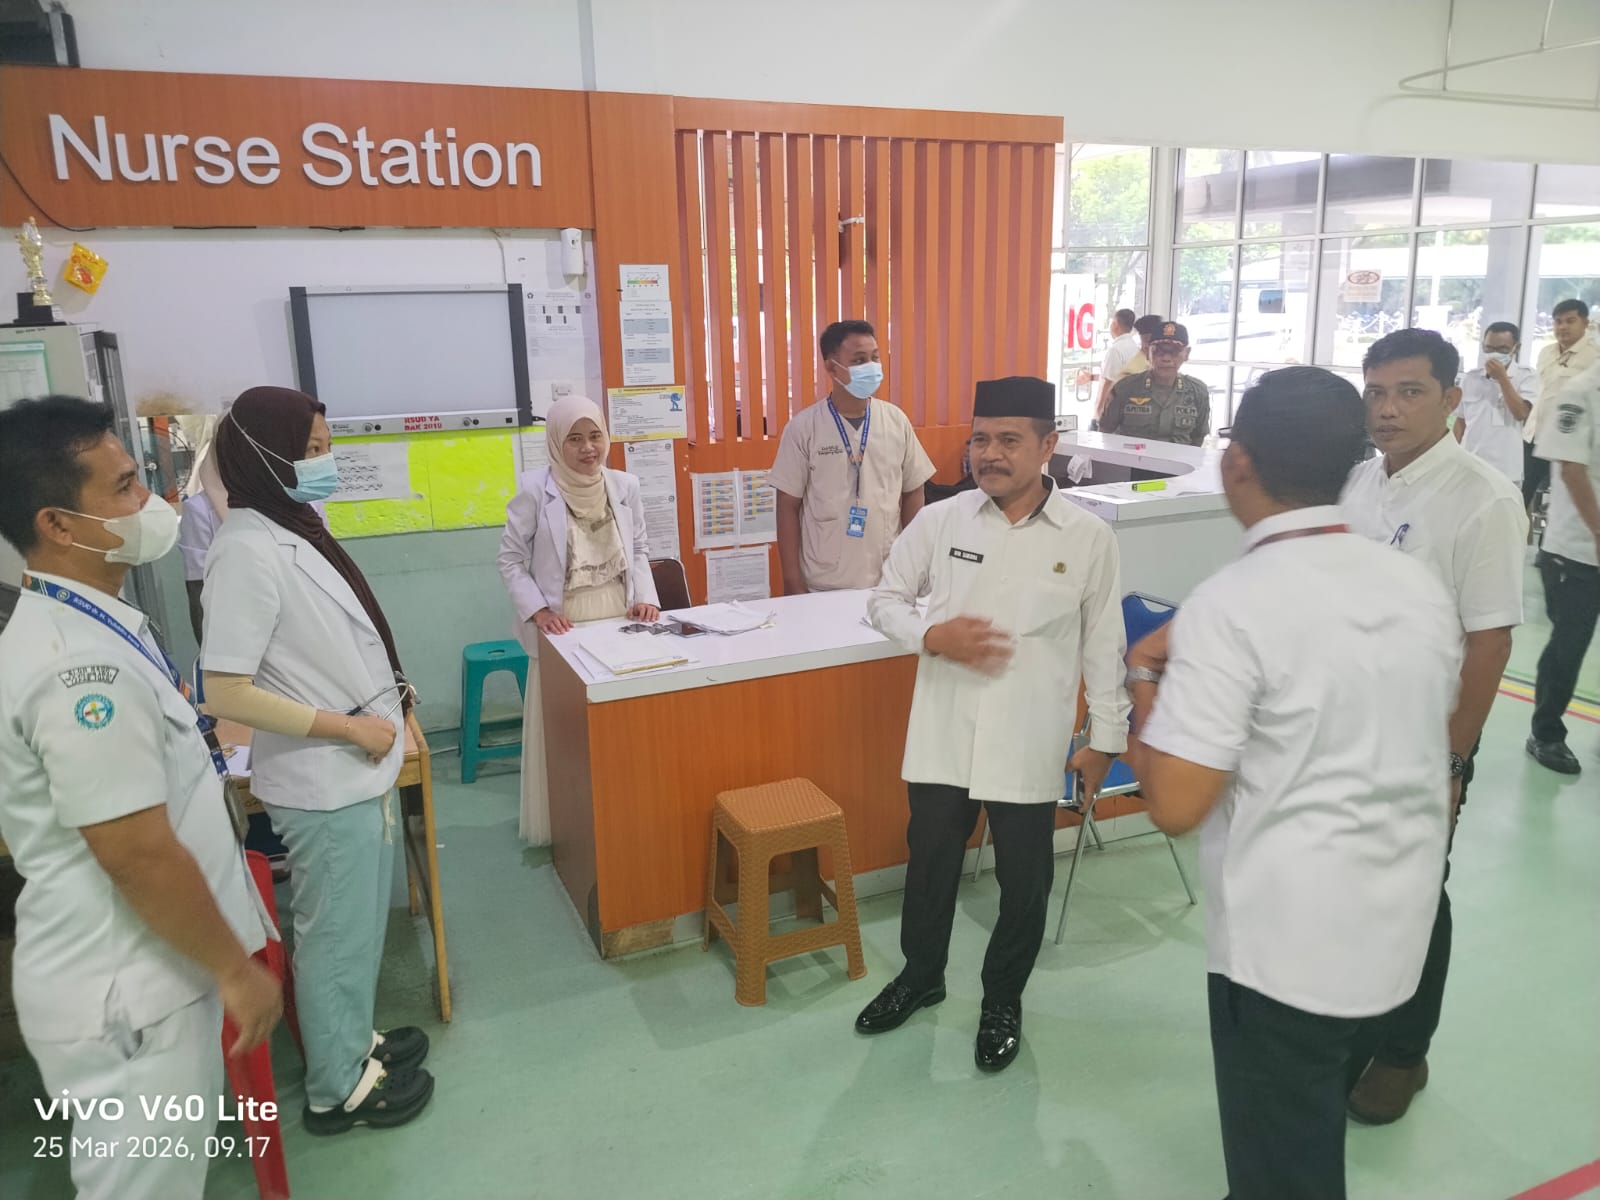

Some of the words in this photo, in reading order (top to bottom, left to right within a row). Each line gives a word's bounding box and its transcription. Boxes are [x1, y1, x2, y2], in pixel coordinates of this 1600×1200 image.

[48, 113, 281, 186] Nurse
[301, 121, 543, 189] Station
[404, 416, 427, 424] RSUD
